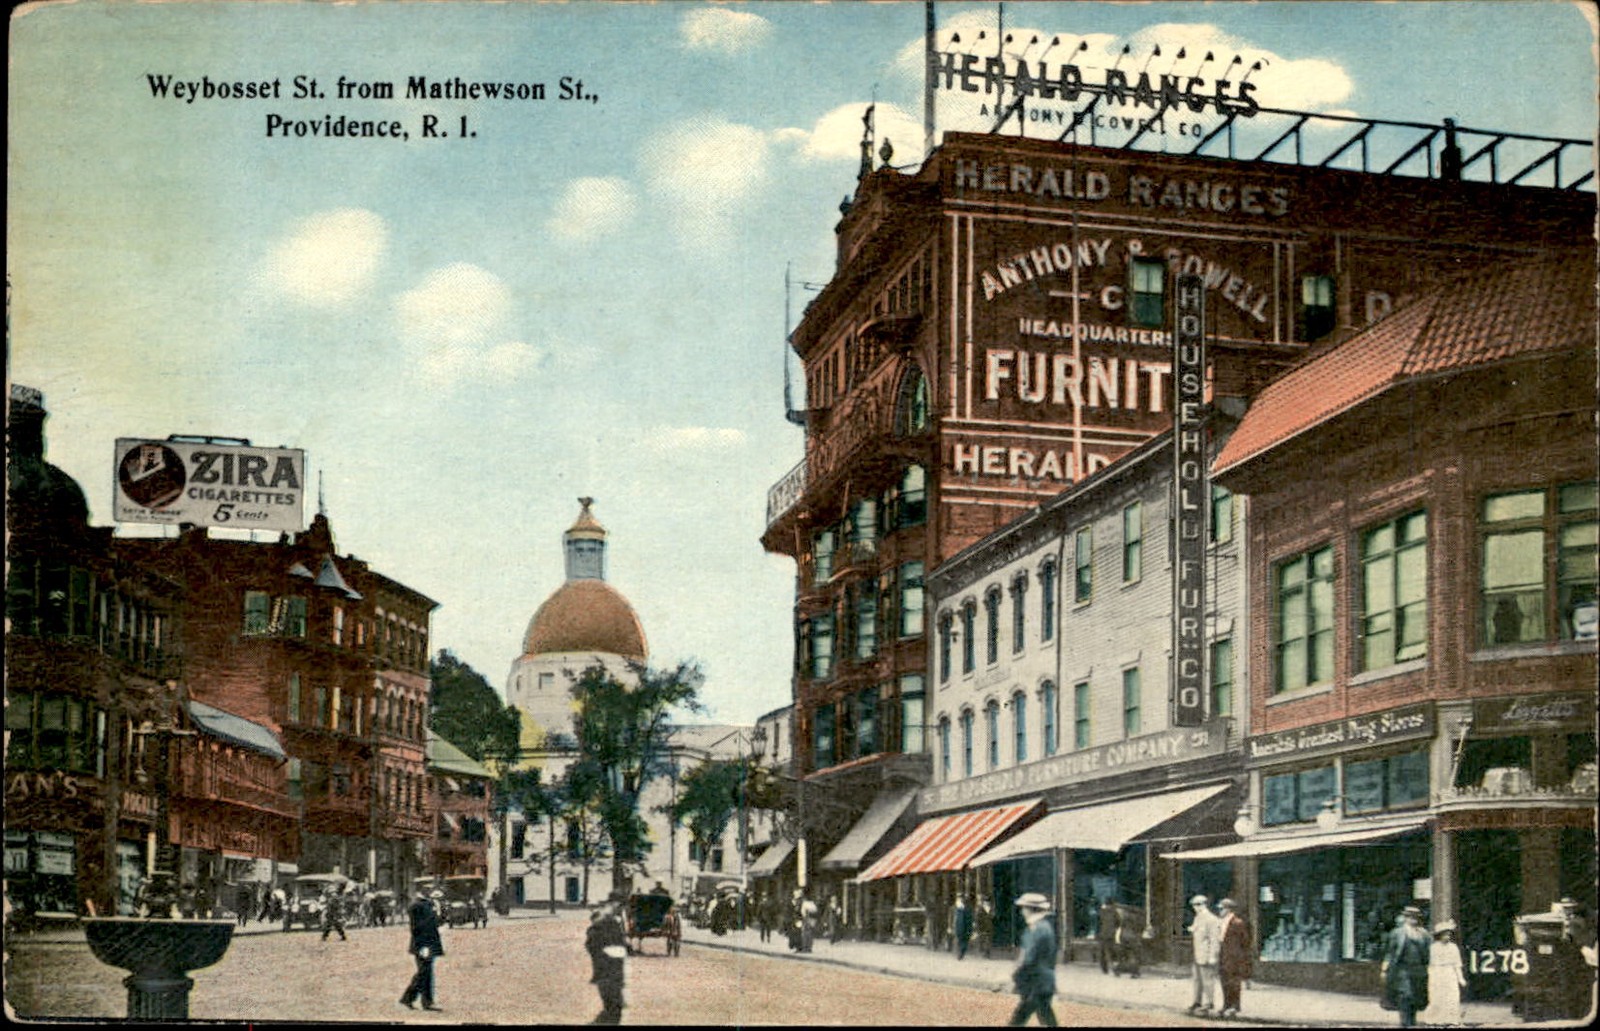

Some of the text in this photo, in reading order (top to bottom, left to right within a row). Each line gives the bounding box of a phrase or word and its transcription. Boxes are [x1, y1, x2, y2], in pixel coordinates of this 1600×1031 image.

[927, 51, 1259, 117] HERALD RANGES
[980, 103, 1065, 124] ANONY
[954, 157, 1289, 216] HERALD RANGES
[980, 238, 1112, 301] ANTHONY
[985, 348, 1173, 413] FURNIT
[1180, 286, 1200, 539] HOUSEHOLD
[188, 487, 296, 506] CIGARETTES
[189, 451, 300, 489] ZIRA
[213, 504, 269, 522] 5 Cents
